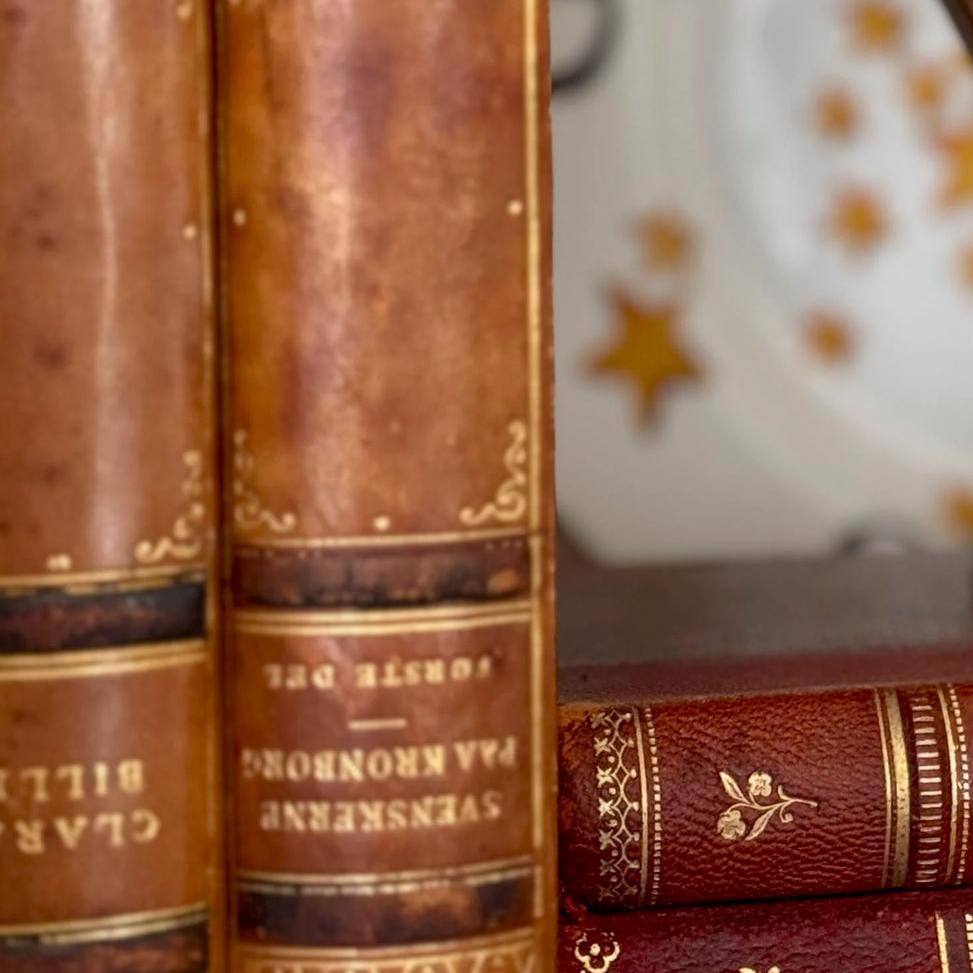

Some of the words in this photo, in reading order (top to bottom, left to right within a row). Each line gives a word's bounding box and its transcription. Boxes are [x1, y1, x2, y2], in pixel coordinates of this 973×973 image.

[263, 663, 336, 689] DEL
[242, 743, 447, 783] KRONBORG
[453, 736, 518, 772] PAA
[259, 789, 502, 834] SVENSKERNE
[0, 809, 161, 855] CLAR
